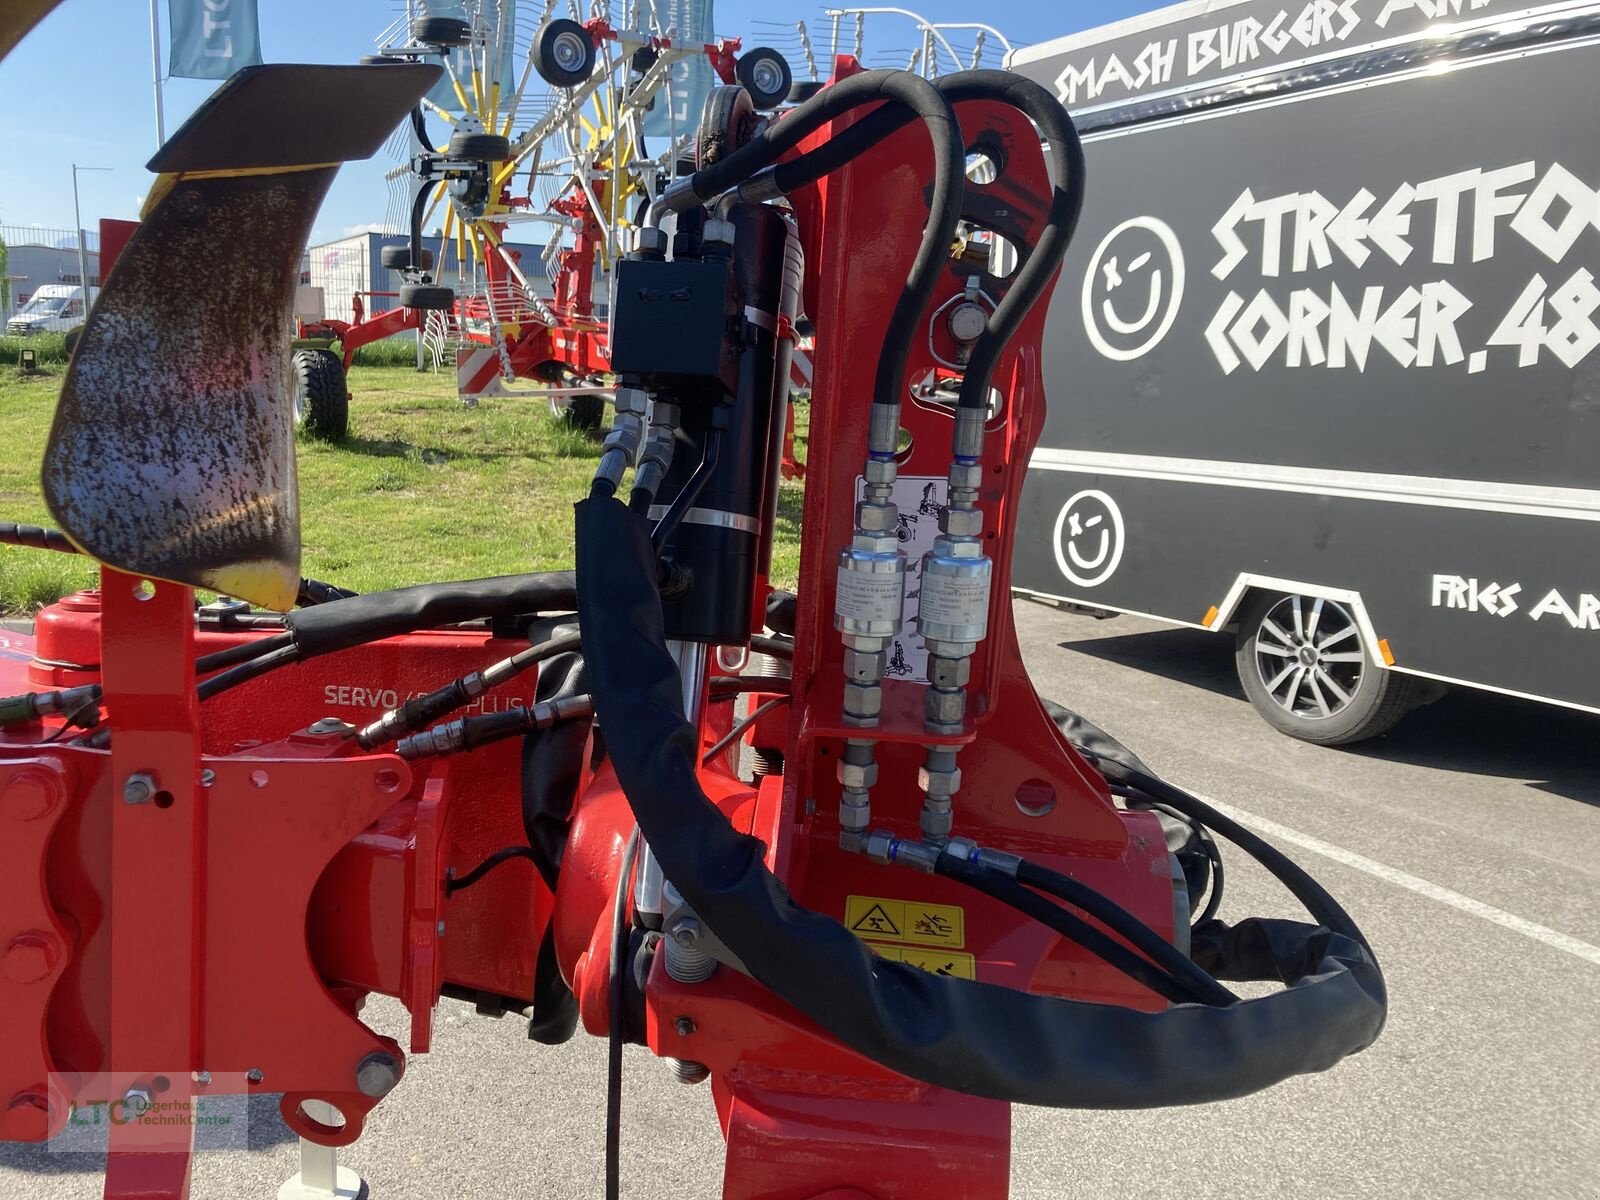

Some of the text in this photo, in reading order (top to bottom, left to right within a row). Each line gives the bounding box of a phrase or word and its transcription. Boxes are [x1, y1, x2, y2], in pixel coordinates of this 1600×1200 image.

[1054, 0, 1361, 104] SMASH BURGERS
[1210, 160, 1600, 281] STREETFO
[1431, 574, 1600, 630] FRIES AR
[324, 685, 398, 709] SERVO
